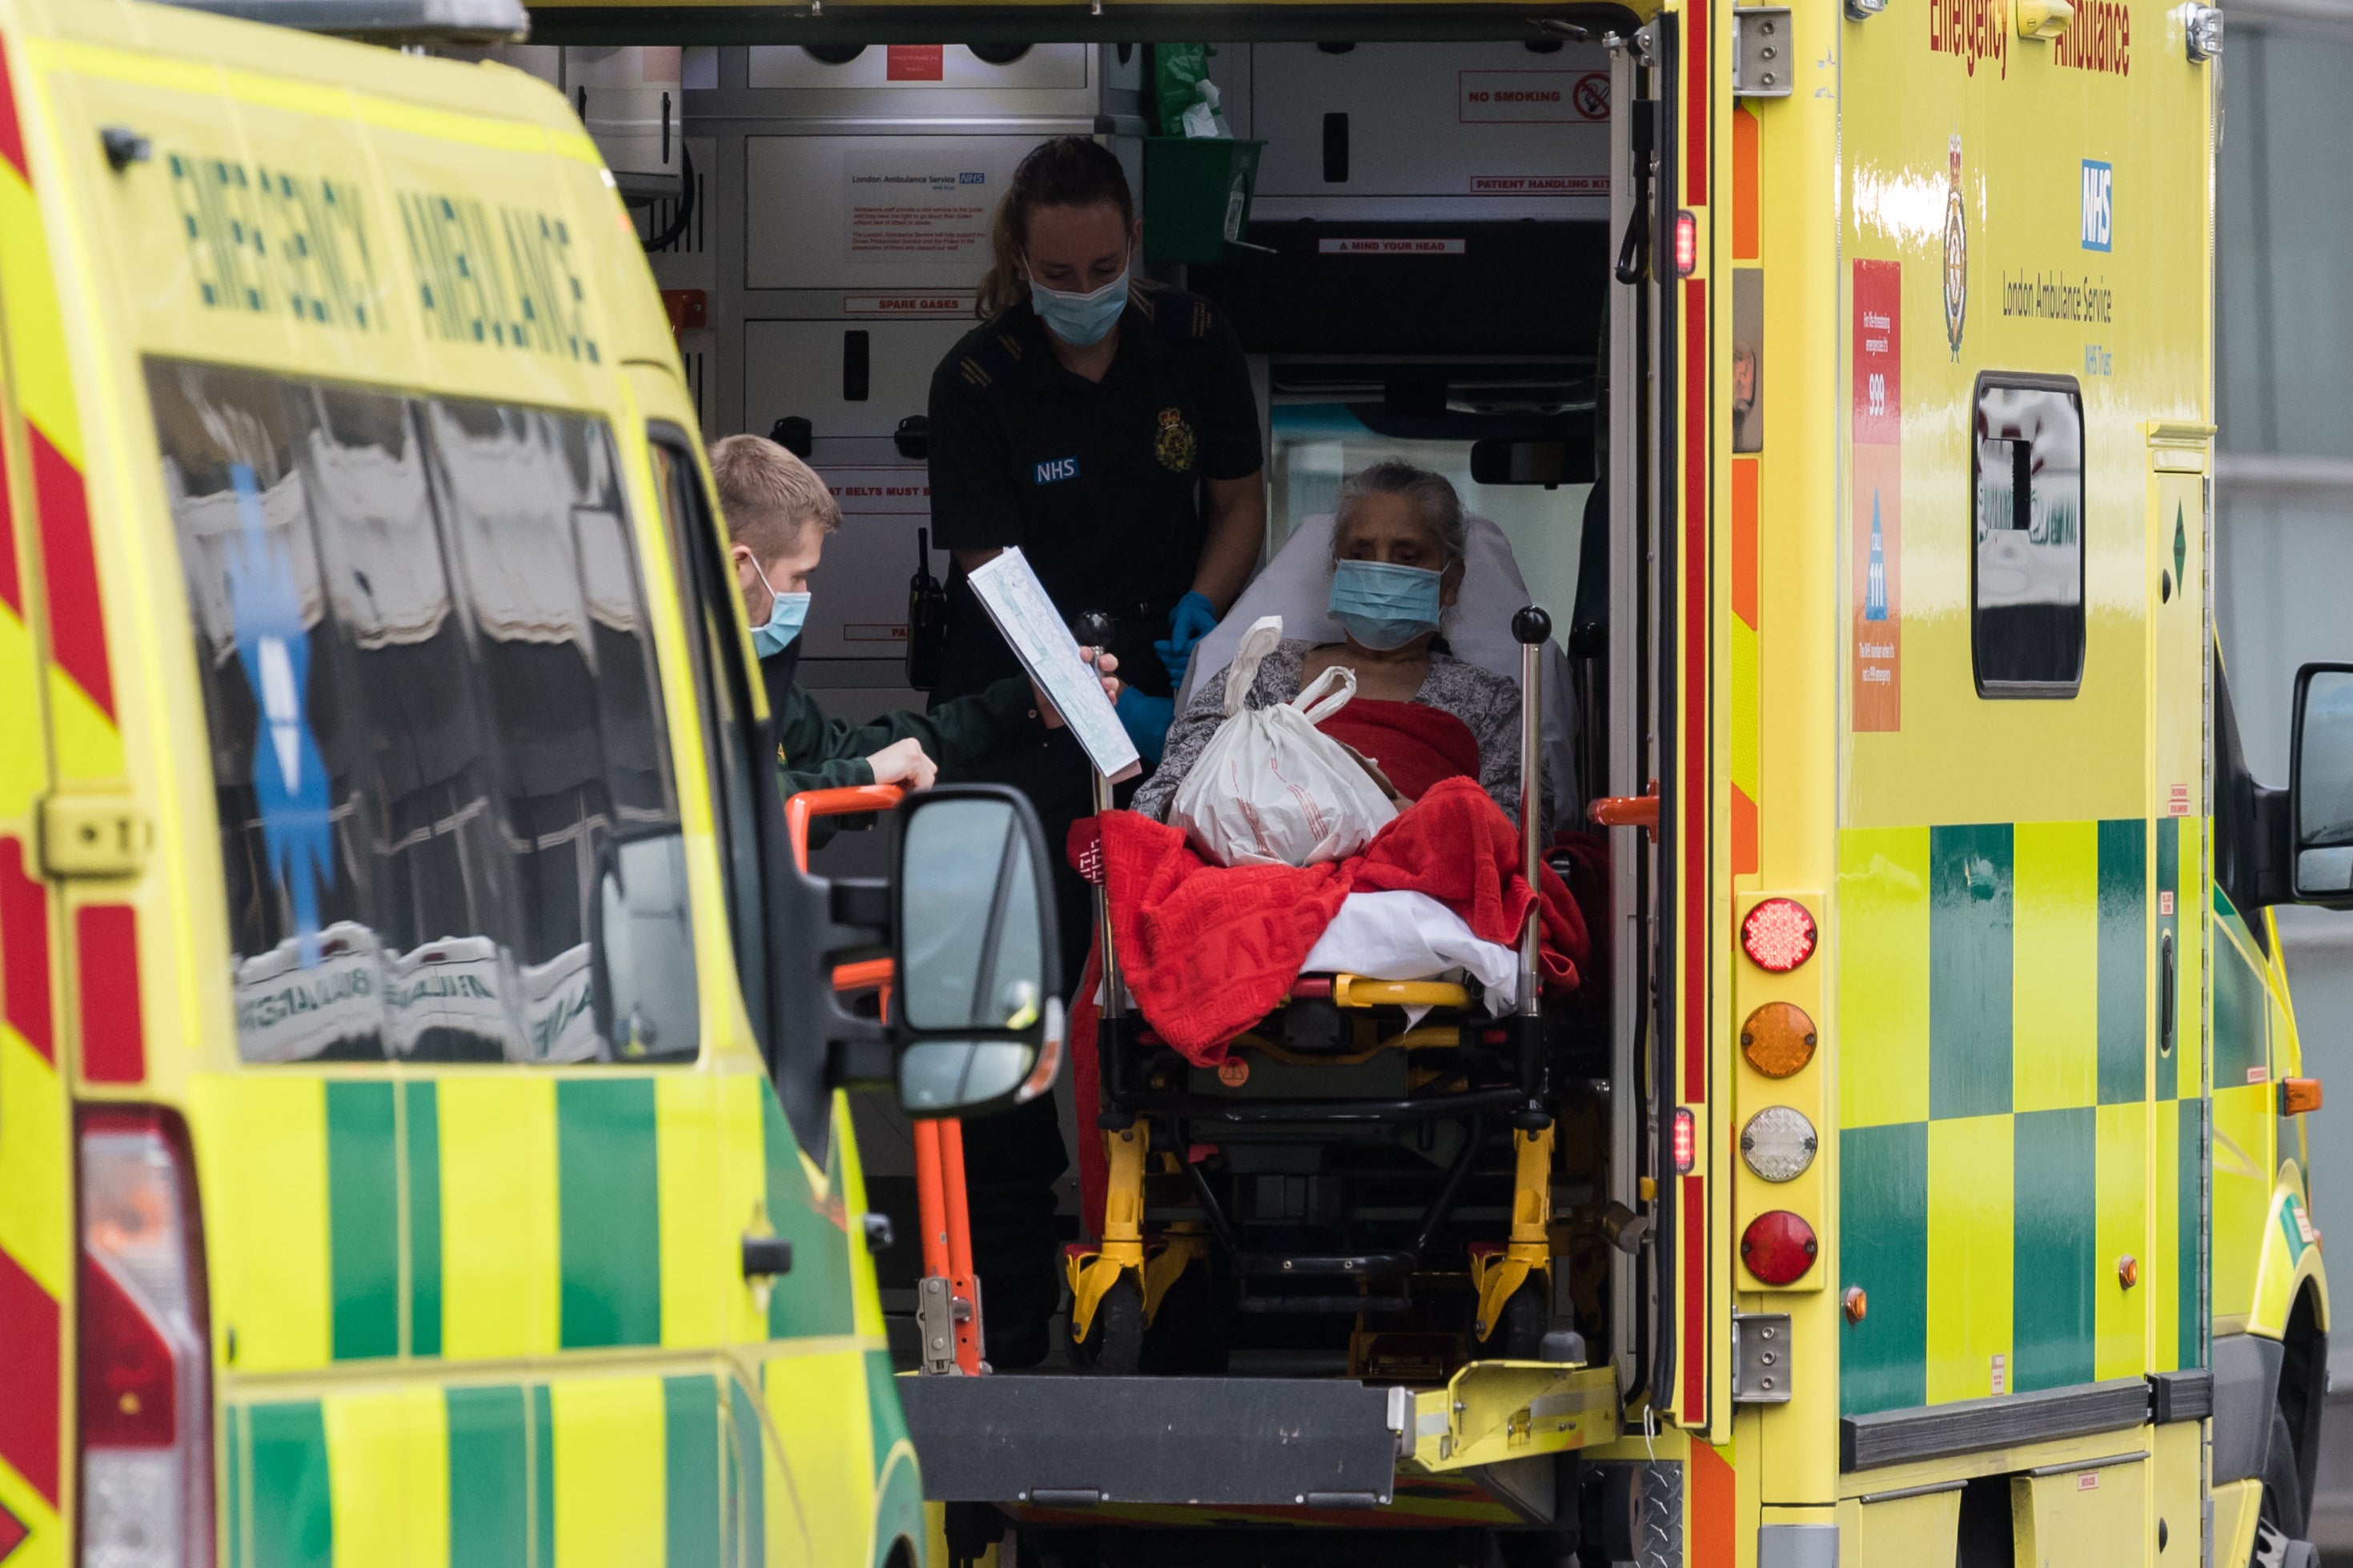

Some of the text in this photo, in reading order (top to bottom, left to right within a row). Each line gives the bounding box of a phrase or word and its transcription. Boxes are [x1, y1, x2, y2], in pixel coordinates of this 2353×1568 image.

[1469, 90, 1561, 102] NO SMOKING
[852, 173, 983, 183] London Ambulance Service NHS
[1476, 178, 1525, 189] PATIENT
[1528, 178, 1589, 189] HANDLING
[2082, 166, 2112, 246] NHS
[1351, 241, 1446, 251] MIND YOUR HEAD
[2002, 267, 2111, 323] London Ambulance Service
[878, 299, 959, 310] SPARE GASES
[1869, 373, 1885, 416] 999
[1036, 459, 1076, 481] NHS
[829, 487, 931, 496] AT BELTS MUST B
[1869, 563, 1883, 607] 111
[891, 628, 906, 636] PA
